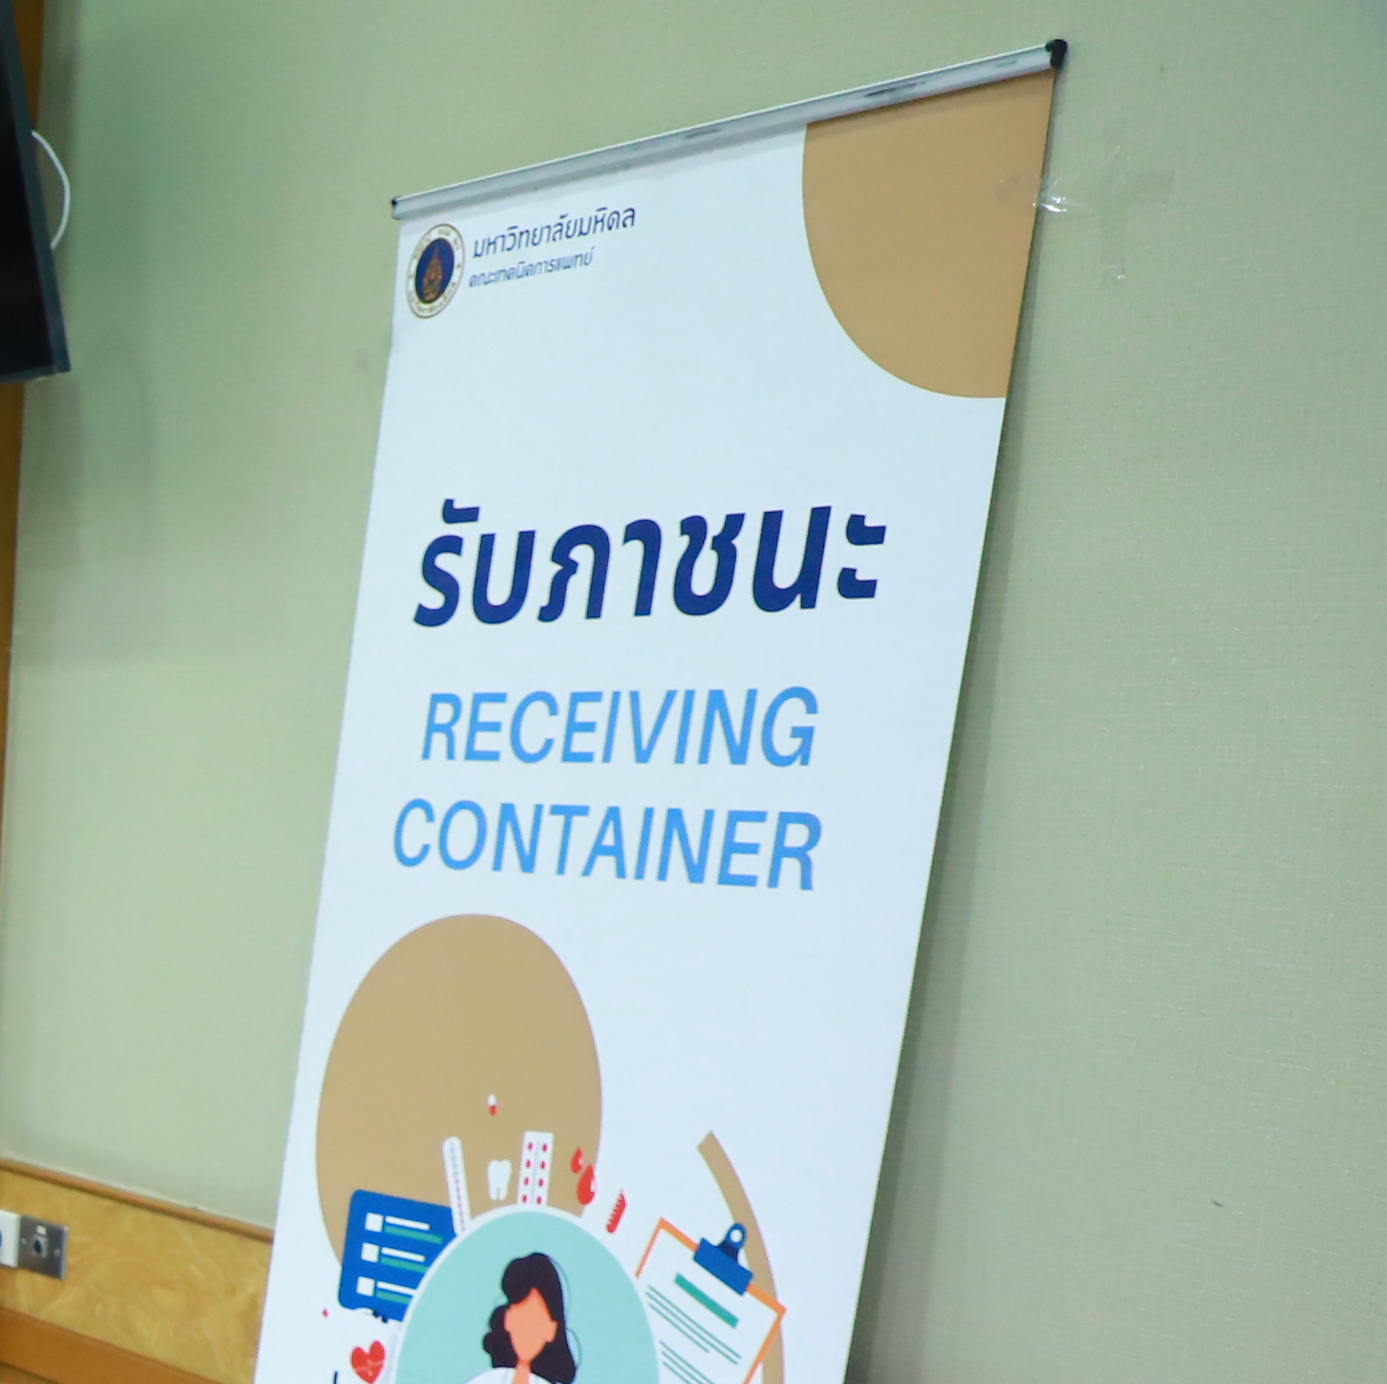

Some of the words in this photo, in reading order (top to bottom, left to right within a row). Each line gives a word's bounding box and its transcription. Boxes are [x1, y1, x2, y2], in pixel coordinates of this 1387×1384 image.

[472, 207, 635, 258] มหาวิทยาลัยมหิดล
[414, 498, 887, 627] รับภาชนะ
[422, 686, 818, 767] RECEIVING
[393, 798, 822, 890] CONTAINER
